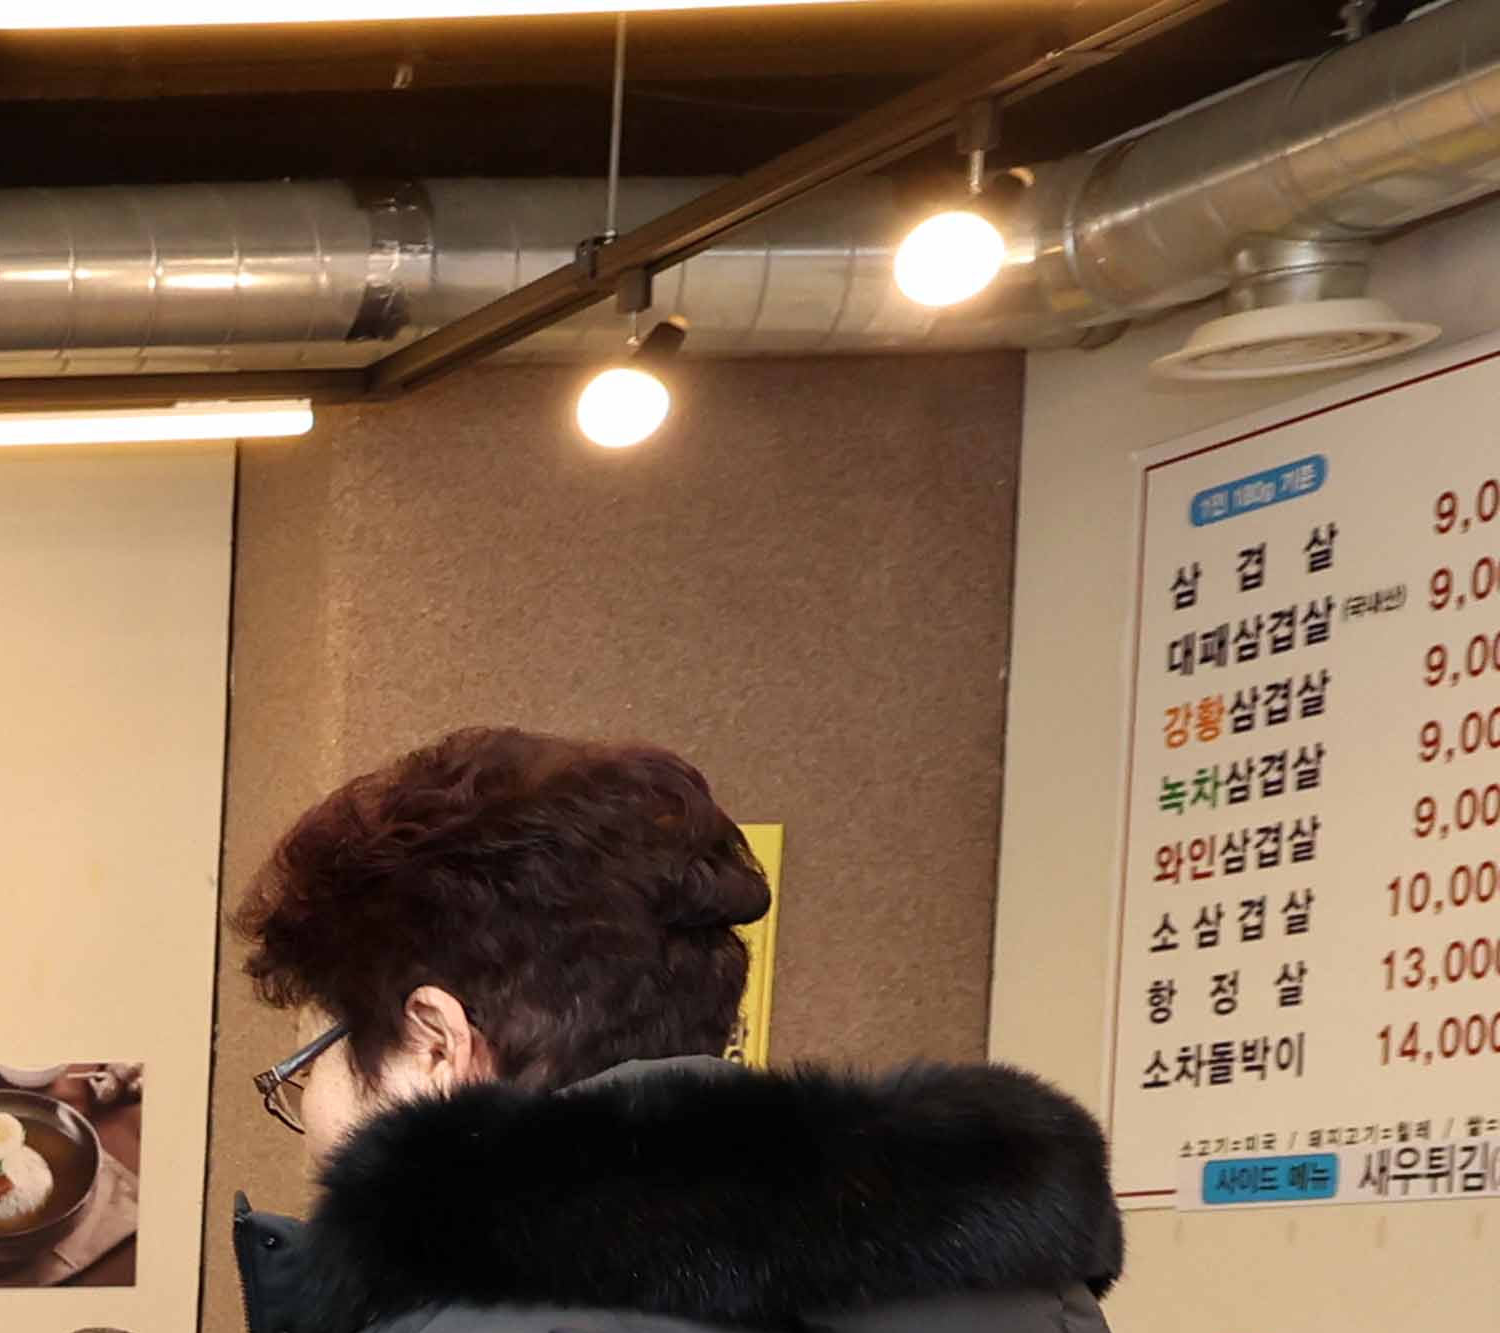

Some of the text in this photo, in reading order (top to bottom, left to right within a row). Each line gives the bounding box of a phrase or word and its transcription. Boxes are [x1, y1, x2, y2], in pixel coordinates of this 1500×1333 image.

[1429, 557, 1500, 611] 9,0
[1167, 595, 1335, 676] 대패삼겹살
[1163, 668, 1331, 749] 강황삼겹살
[1158, 742, 1326, 815] 녹차삼겹살
[1153, 815, 1322, 885] 와인삼겹살
[1386, 860, 1500, 917] 10,00
[1380, 937, 1500, 991] 13,00
[1141, 1031, 1305, 1090] 소차돌박이
[1215, 1166, 1279, 1194] 사이드
[1287, 1161, 1330, 1191] 메뉴
